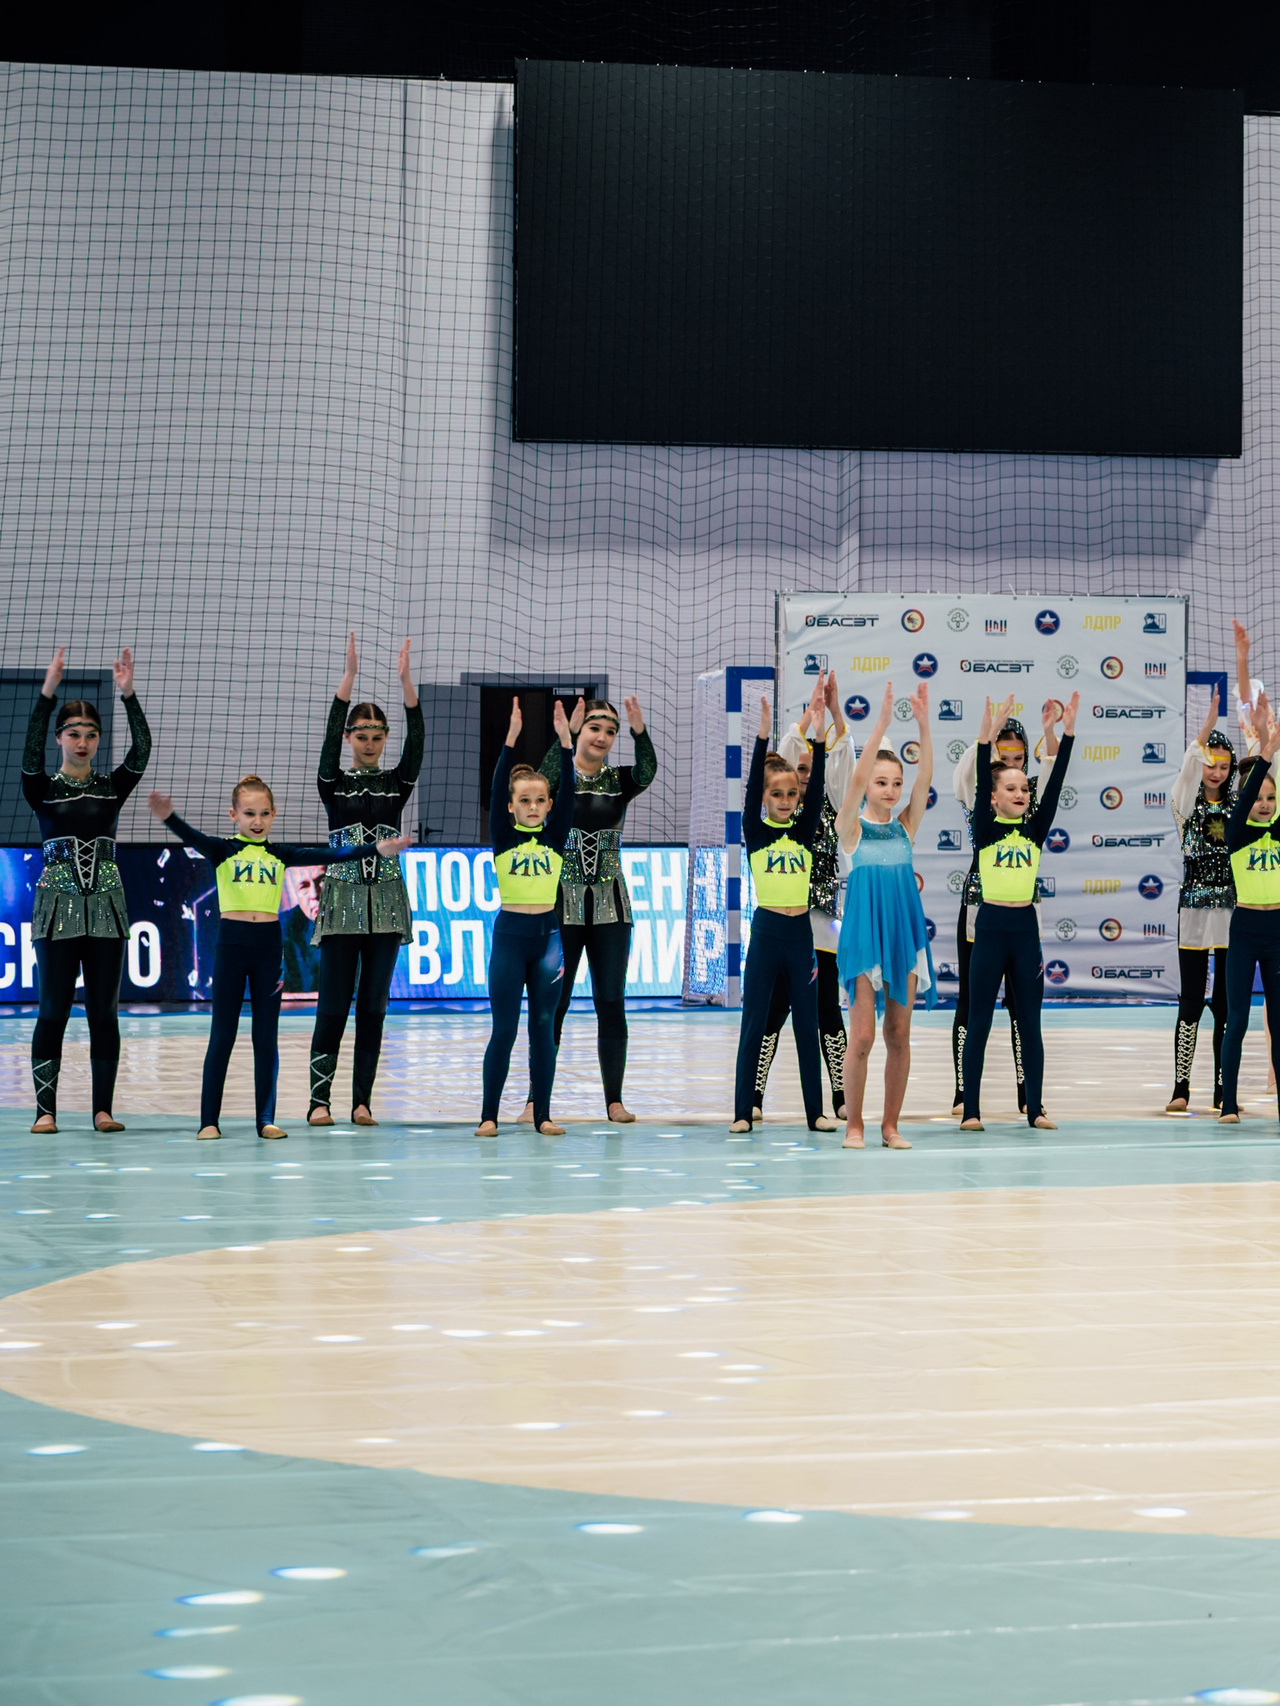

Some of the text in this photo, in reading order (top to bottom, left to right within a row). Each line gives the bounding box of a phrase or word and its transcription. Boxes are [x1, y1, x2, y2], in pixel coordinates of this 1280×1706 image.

[816, 617, 879, 627] БАСЭТ
[1082, 614, 1122, 633] ЛДПР
[850, 655, 891, 674] ЛДПР
[972, 663, 1035, 673] БАСЭТ
[1105, 708, 1166, 719] БАСЭТ
[1081, 745, 1121, 763] ЛДПР
[1104, 837, 1165, 847] БАСЭТ
[1081, 879, 1122, 895] ЛДПР
[1104, 969, 1165, 979] БАСЭТ
